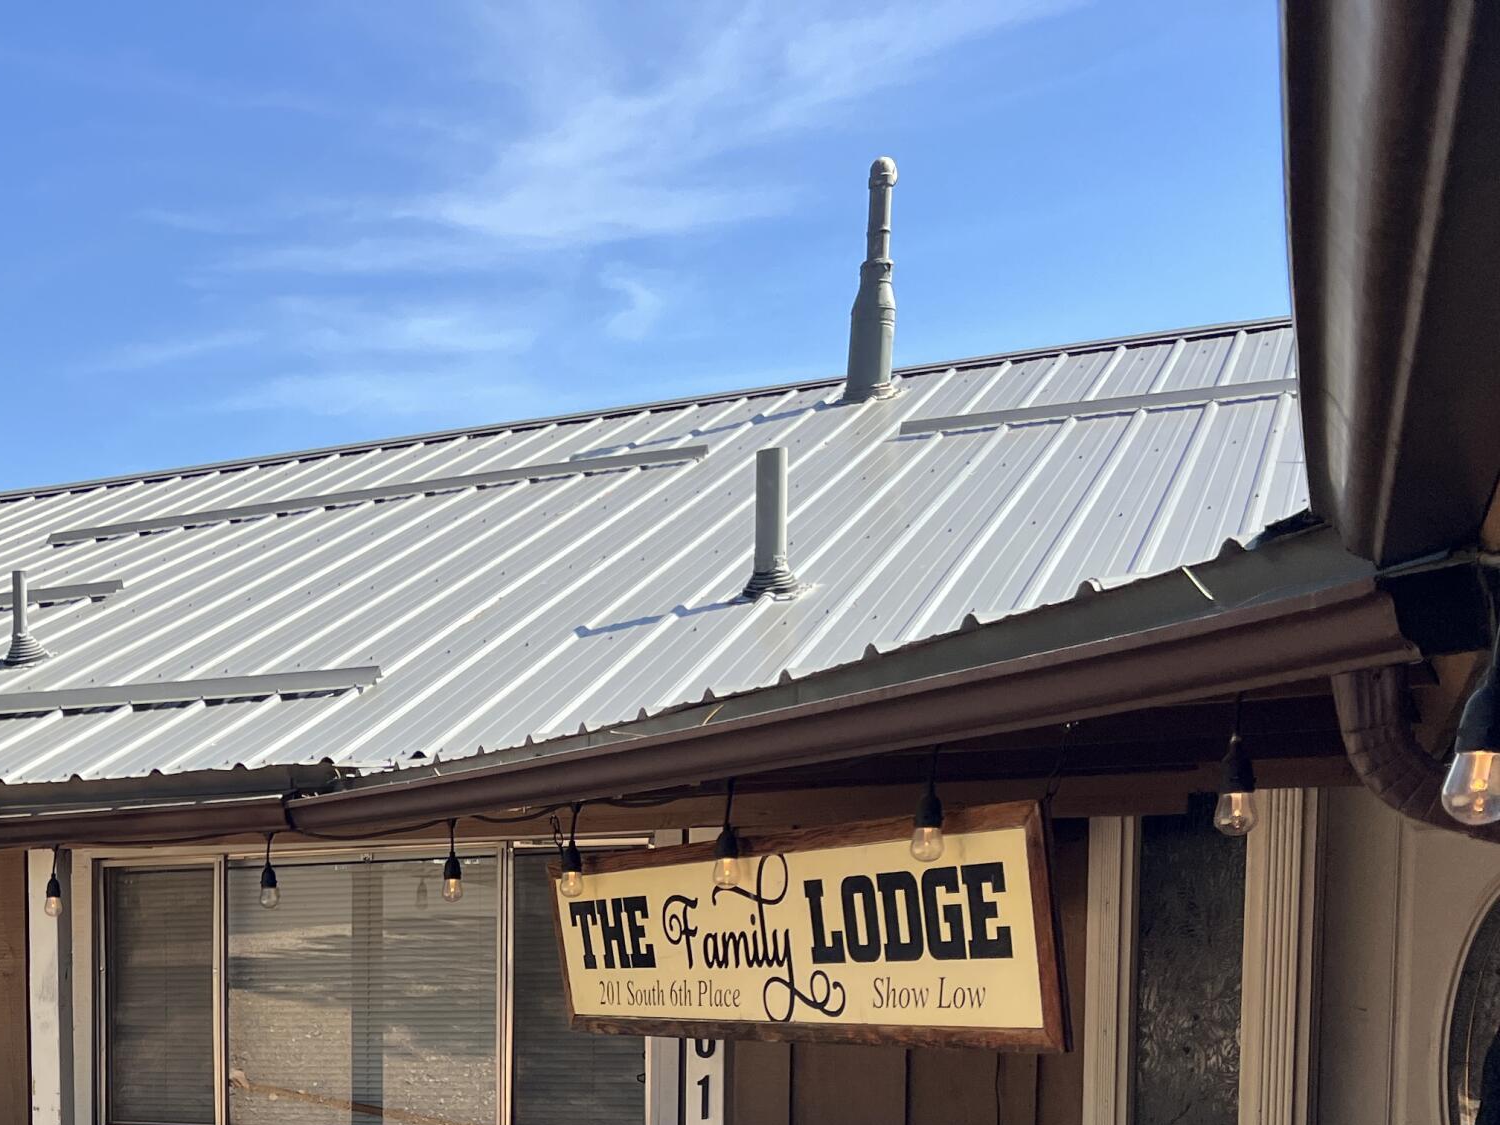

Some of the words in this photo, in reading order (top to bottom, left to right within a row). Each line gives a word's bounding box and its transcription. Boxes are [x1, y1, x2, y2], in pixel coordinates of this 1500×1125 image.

[569, 896, 657, 970] THE
[662, 853, 846, 1023] Family
[803, 861, 1014, 965] LODGE
[599, 980, 622, 1006] 201
[627, 980, 665, 1007] South
[670, 980, 693, 1007] 6th
[698, 980, 741, 1009] Place
[872, 977, 930, 1010] Show
[937, 976, 987, 1010] Low
